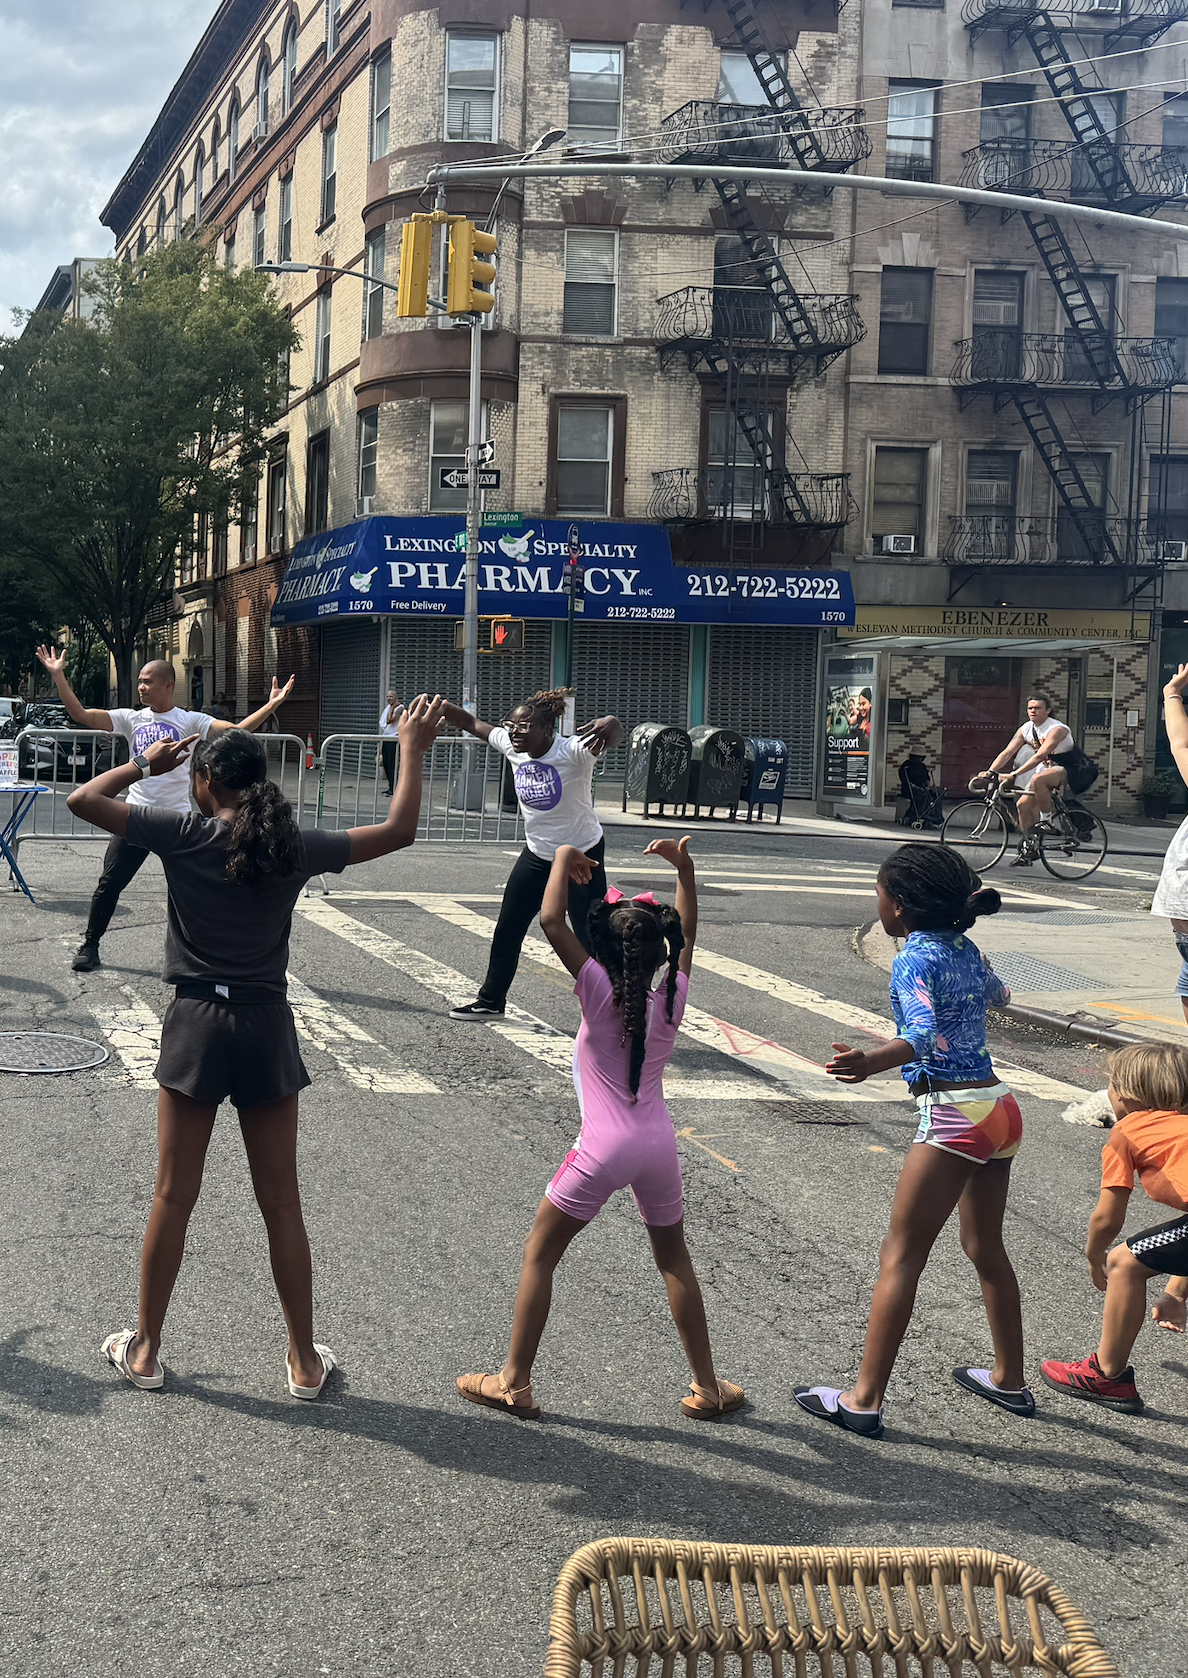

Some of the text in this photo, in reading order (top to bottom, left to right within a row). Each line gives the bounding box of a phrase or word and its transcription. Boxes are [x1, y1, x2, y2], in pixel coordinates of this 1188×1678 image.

[449, 474, 467, 483] ONE
[483, 512, 519, 523] Lexington
[276, 565, 347, 604] PHARMACY
[687, 574, 841, 600] 212-722-5222
[639, 588, 653, 597] INC
[349, 600, 373, 611] 1570
[391, 600, 447, 612] Free Delivery
[607, 606, 676, 619] 212-722-5222
[821, 611, 846, 621] 1570
[941, 610, 1049, 626] EBENEZER
[847, 624, 898, 634] WESLEYAN
[901, 625, 958, 635] METHODIST
[961, 626, 1003, 636] CHURCH
[1006, 628, 1014, 636] &
[1017, 628, 1078, 637] COMMUNITY
[1081, 629, 1121, 638] CENTER,
[135, 729, 174, 746] HARLEM
[828, 735, 860, 750] Support
[521, 764, 537, 773] THE
[514, 768, 553, 788] HARLEM
[515, 780, 556, 801] PROJECT
